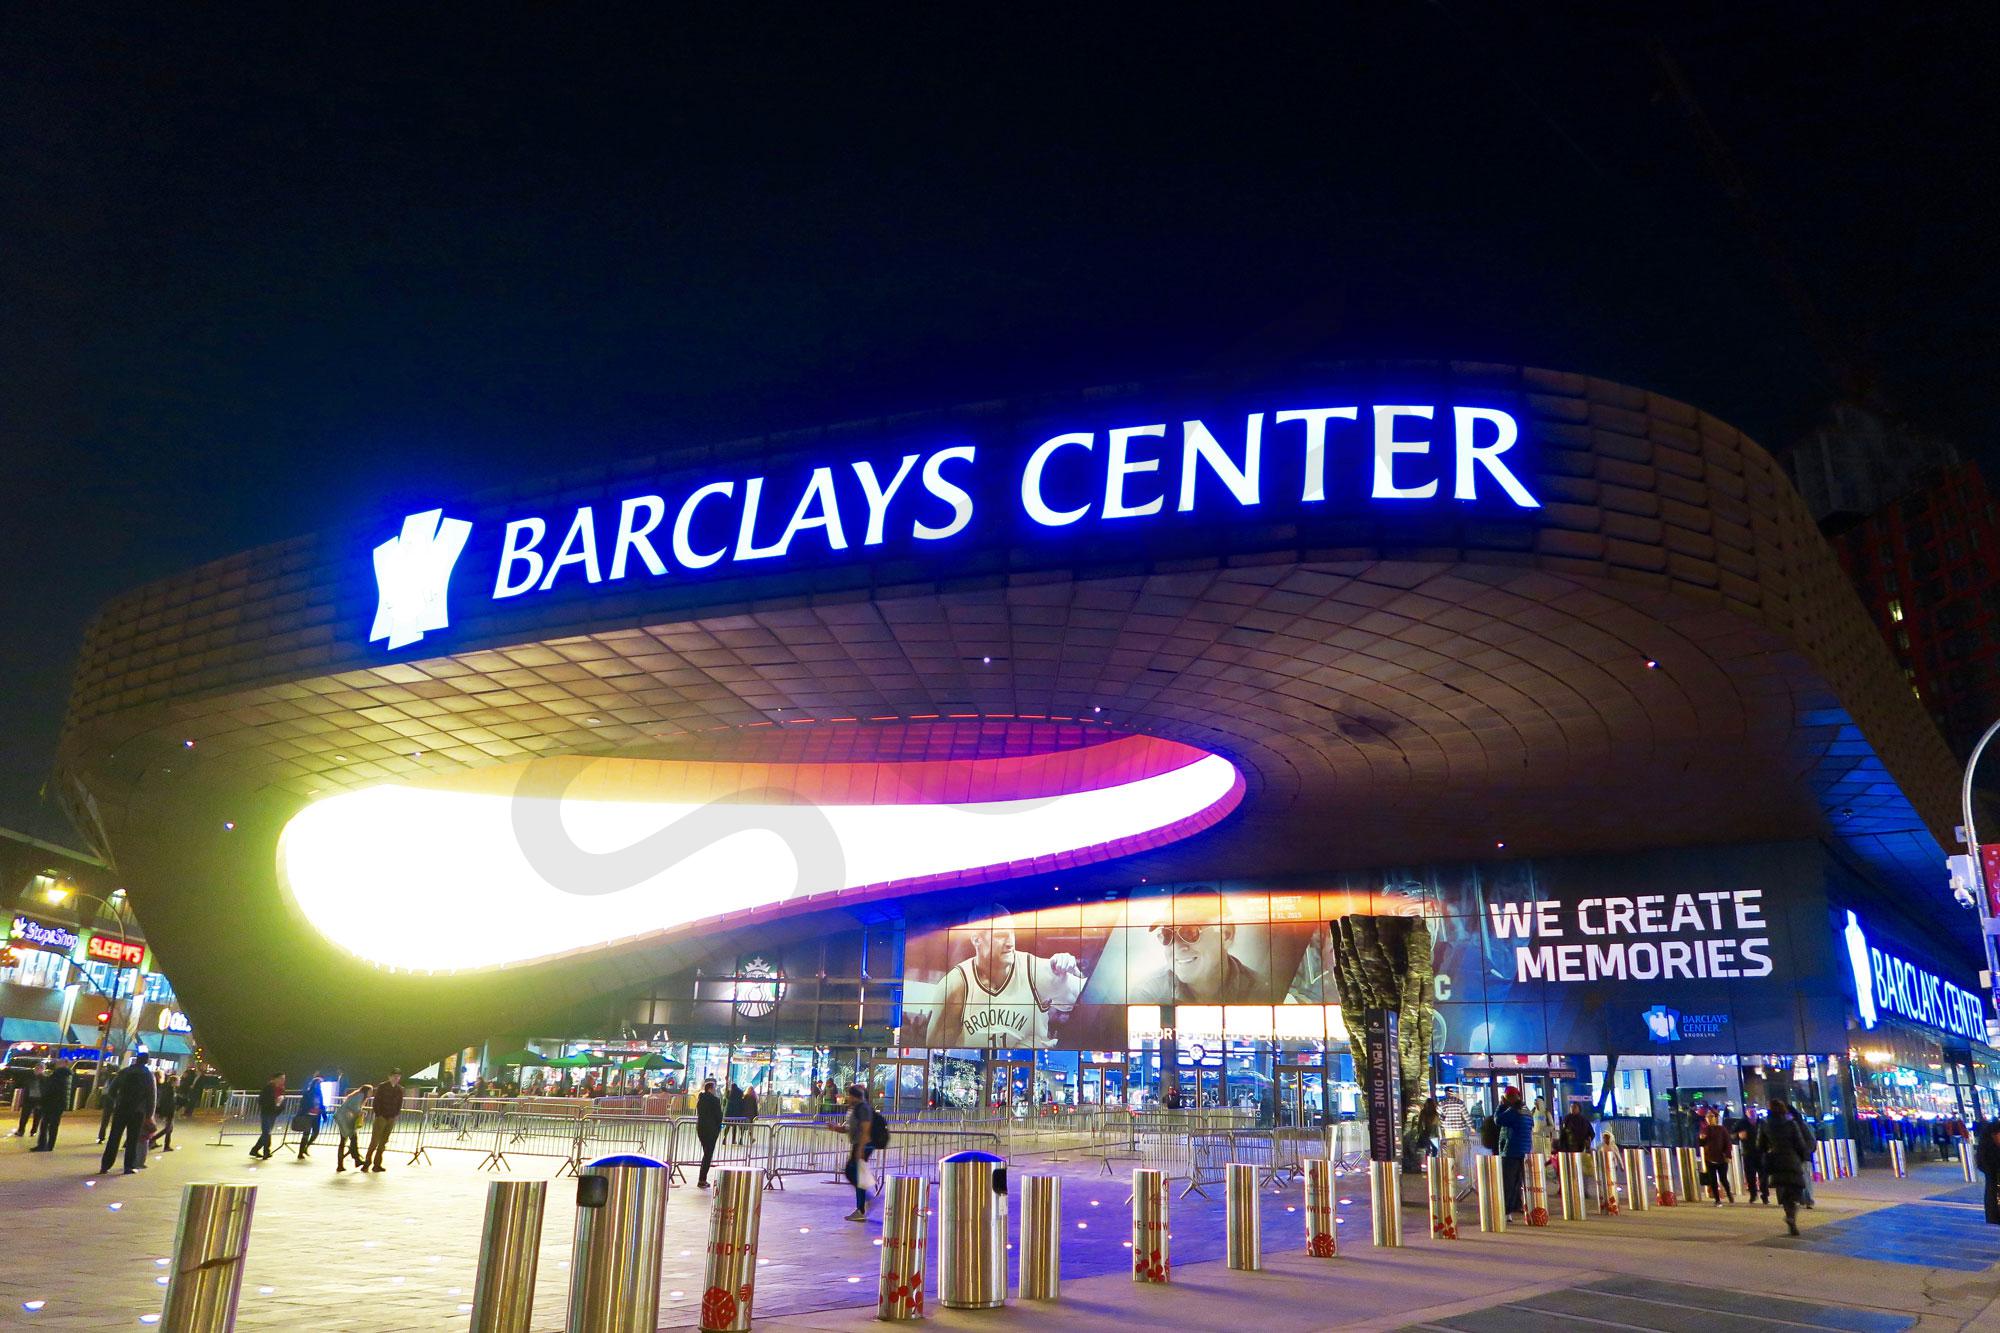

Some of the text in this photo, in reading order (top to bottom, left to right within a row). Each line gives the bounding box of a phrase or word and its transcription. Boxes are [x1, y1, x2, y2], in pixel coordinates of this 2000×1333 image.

[491, 404, 1542, 600] BARCLAYS CENTER
[1489, 889, 1767, 939] WE CREATE
[1515, 937, 1773, 983] MEMORIES
[1871, 946, 1990, 1046] BARCLAYS CENTER
[963, 1008, 1028, 1036] BROOKLYN
[1682, 1015, 1729, 1025] BARCLAYS
[1683, 1024, 1720, 1032] CENTER
[988, 1032, 1008, 1048] 11
[1373, 1079, 1385, 1108] DINE
